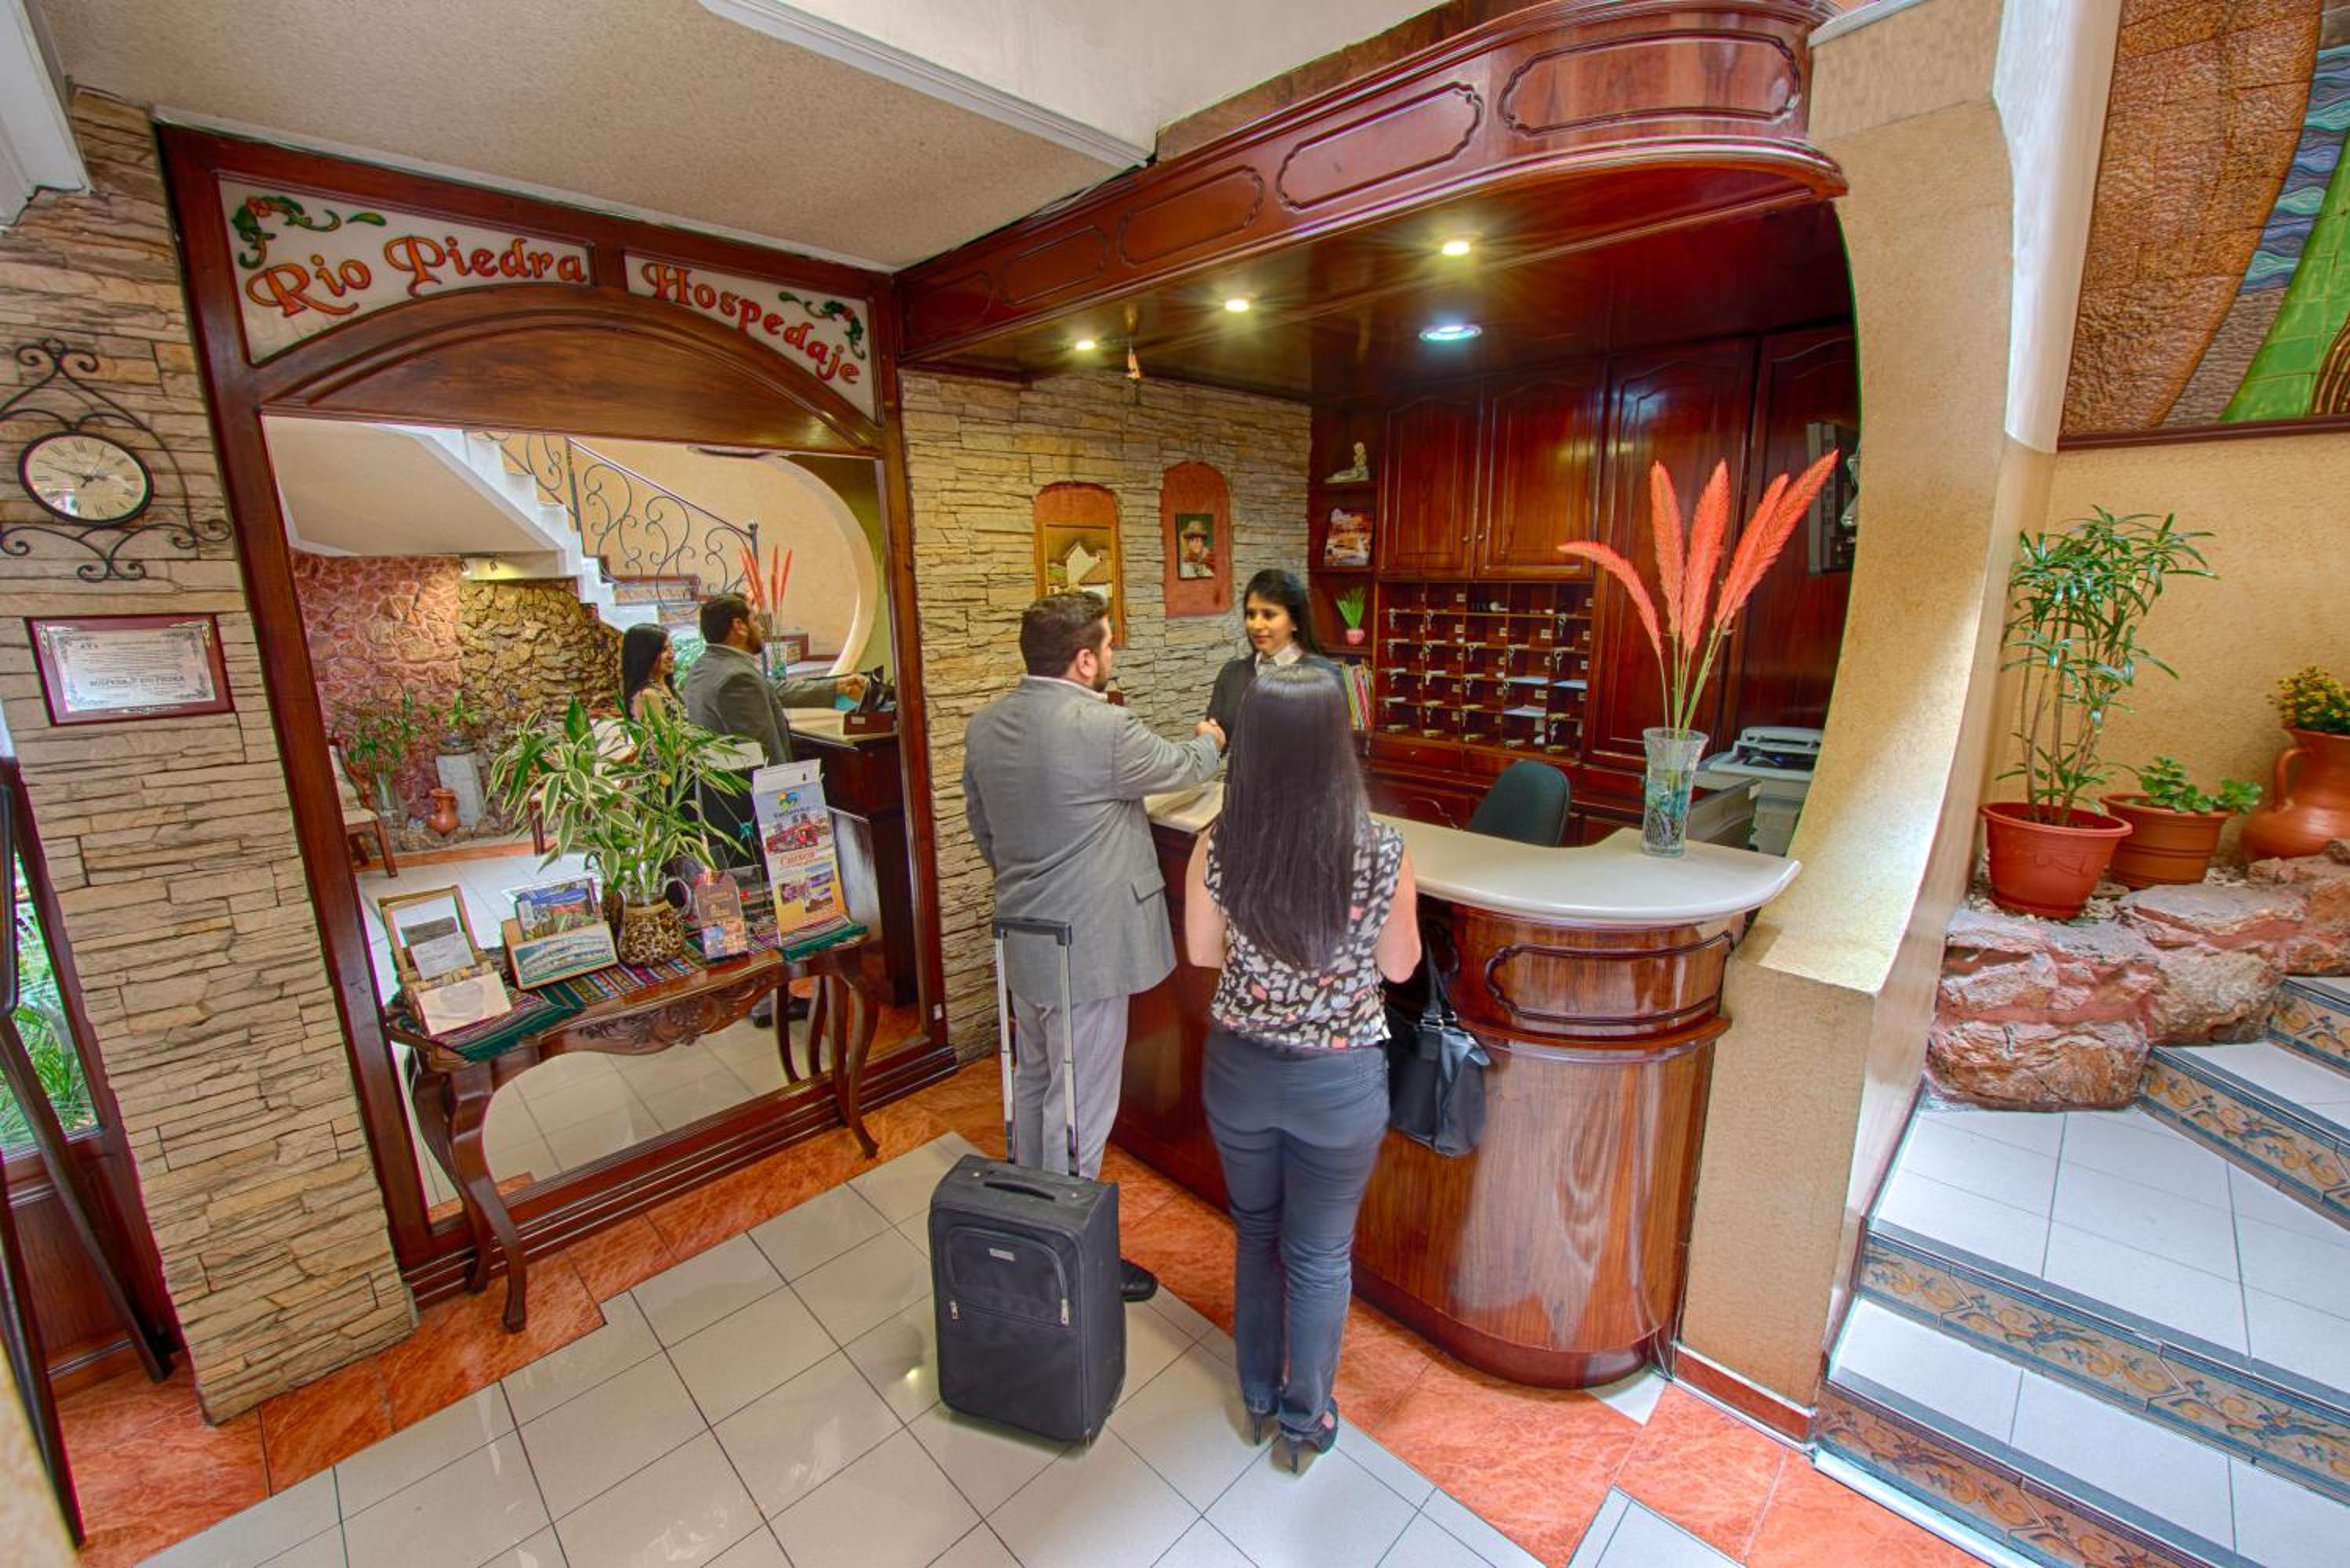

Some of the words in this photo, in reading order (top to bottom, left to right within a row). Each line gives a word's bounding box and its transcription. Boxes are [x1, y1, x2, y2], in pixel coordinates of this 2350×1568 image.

[245, 253, 372, 317] Rio
[383, 233, 588, 298] Piedra
[642, 262, 860, 385] Hospedaje
